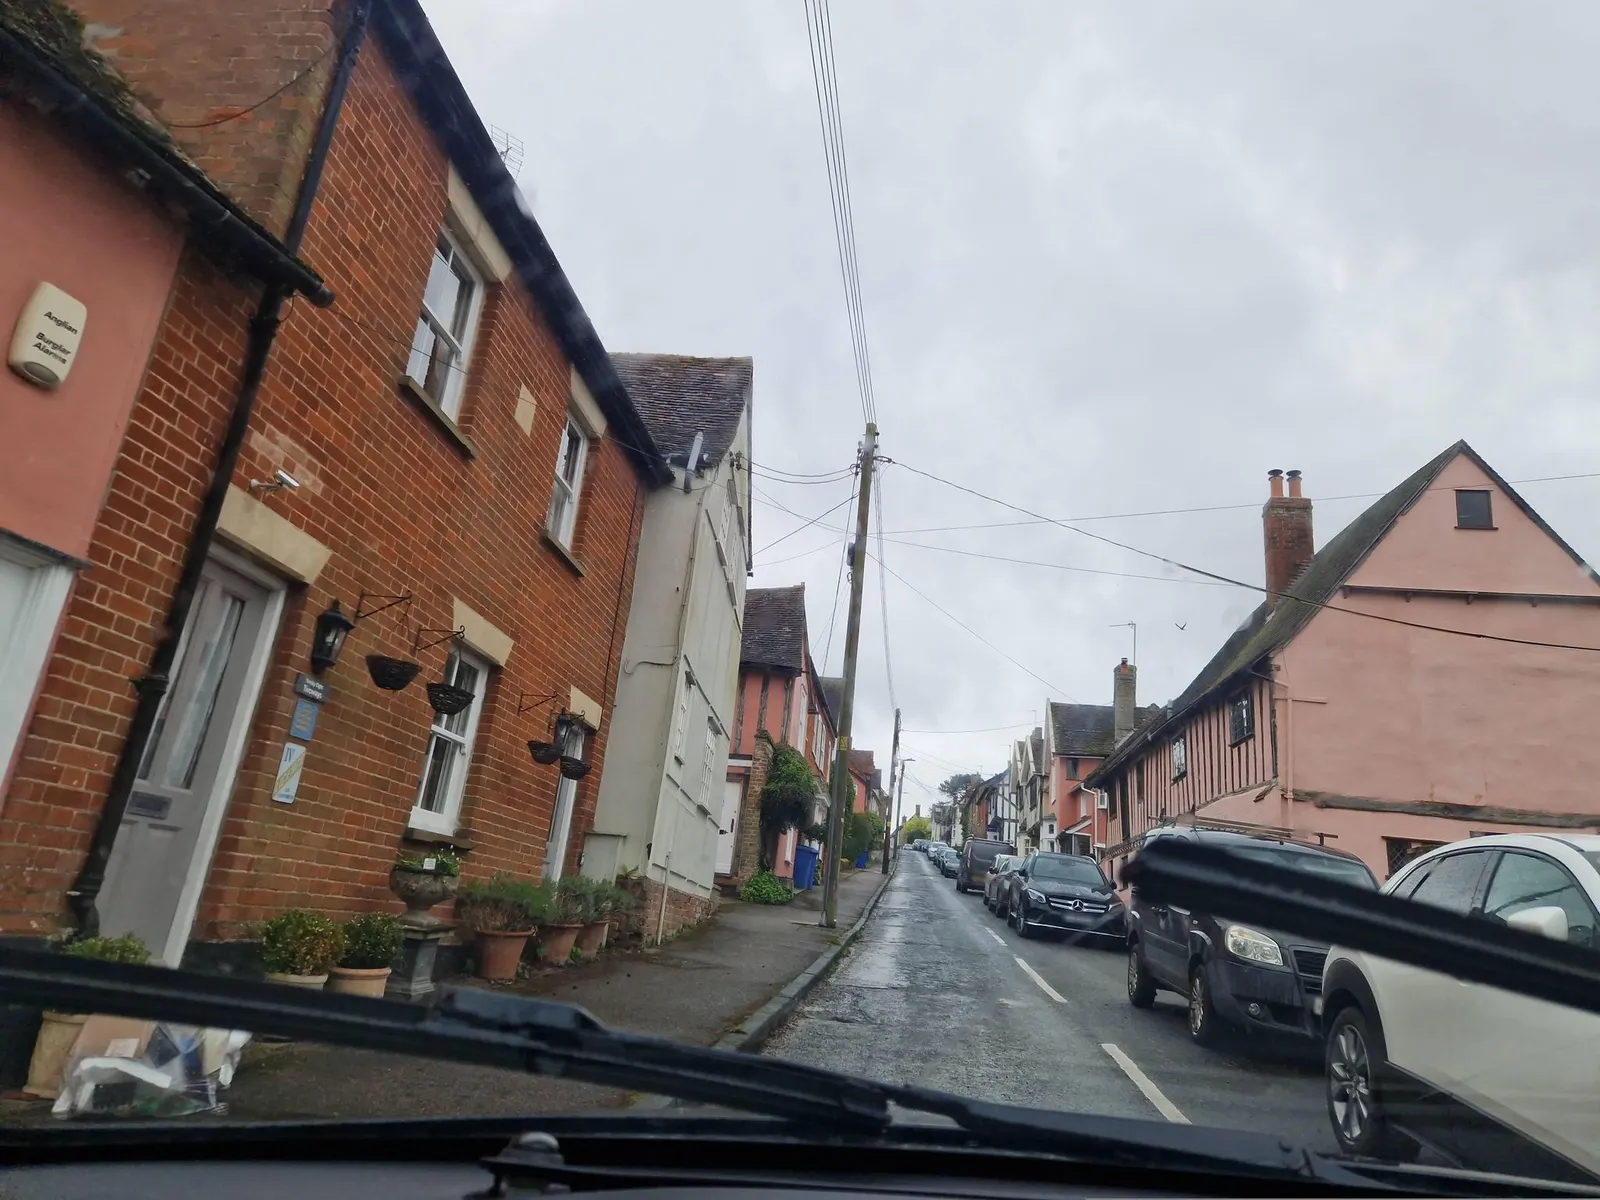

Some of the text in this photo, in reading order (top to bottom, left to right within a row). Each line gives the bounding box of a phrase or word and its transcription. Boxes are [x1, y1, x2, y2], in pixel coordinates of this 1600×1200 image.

[43, 311, 78, 335] Anglian
[32, 342, 67, 364] Alarms
[36, 332, 71, 356] Burglar
